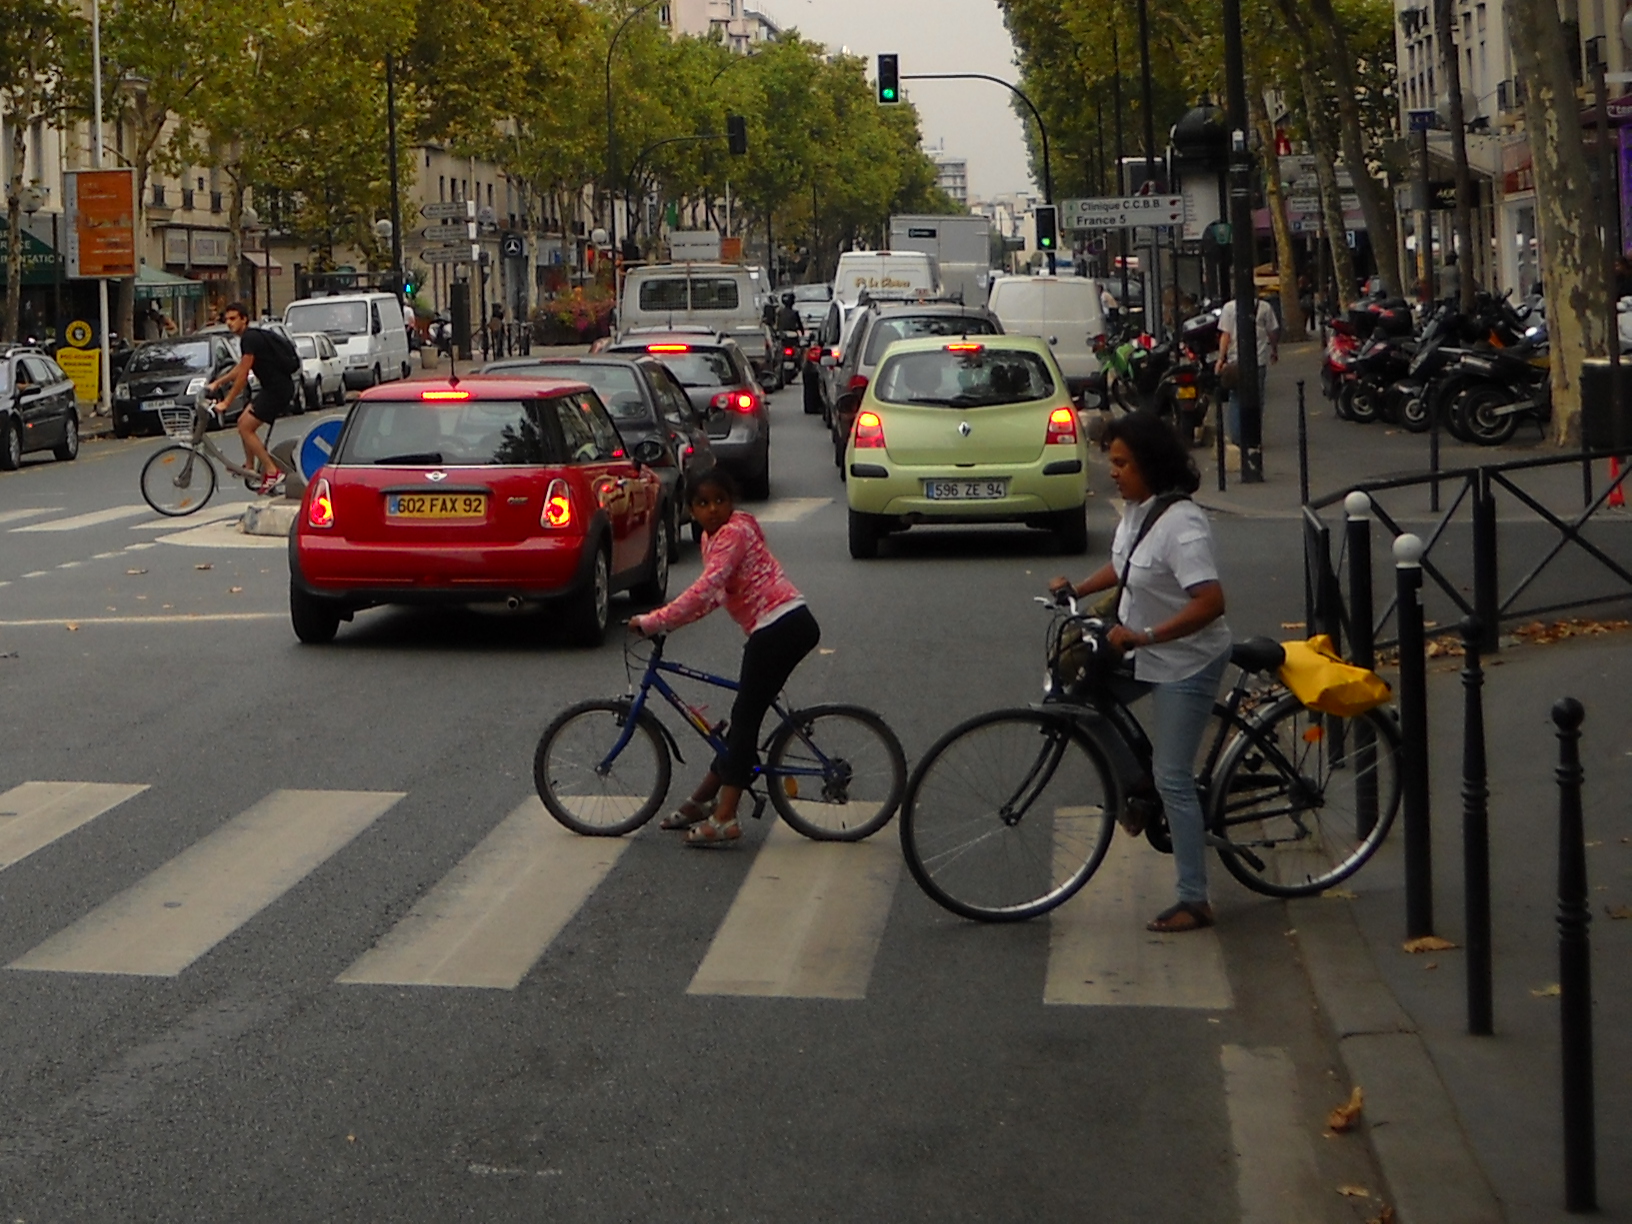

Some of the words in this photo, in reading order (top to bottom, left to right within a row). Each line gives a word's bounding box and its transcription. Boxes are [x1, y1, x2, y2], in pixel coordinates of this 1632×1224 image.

[1081, 202, 1120, 214] Clinique
[1076, 216, 1116, 226] France
[1119, 214, 1126, 224] 5
[936, 484, 959, 496] 596
[965, 484, 980, 496] ZE
[987, 483, 1002, 495] 94
[397, 498, 425, 513] 602
[430, 498, 458, 513] FAX
[463, 498, 483, 513] 92
